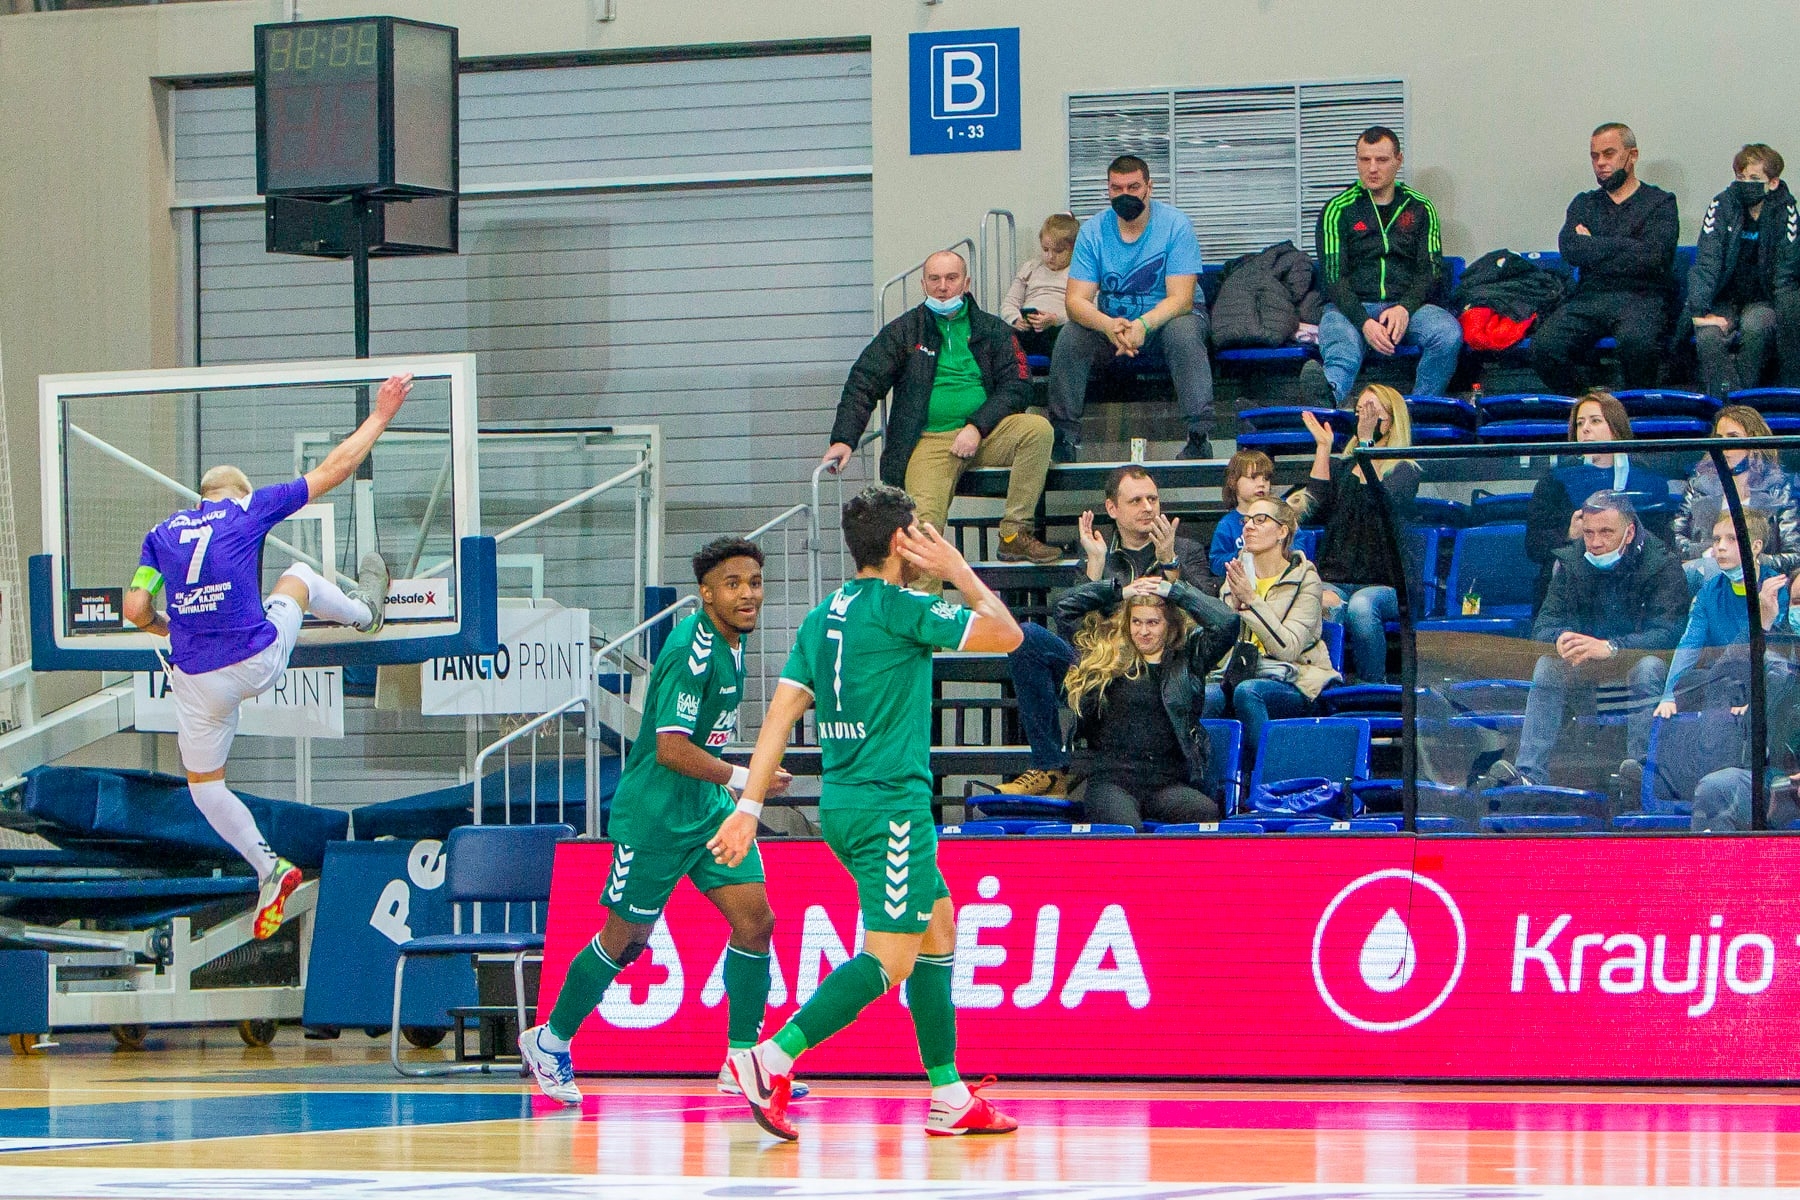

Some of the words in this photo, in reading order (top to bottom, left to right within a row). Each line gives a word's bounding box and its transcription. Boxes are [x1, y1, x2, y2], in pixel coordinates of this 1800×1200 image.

[943, 51, 986, 112] B
[946, 126, 954, 139] 1
[967, 125, 985, 138] 33
[179, 524, 213, 585] 7
[74, 603, 120, 622] JKL
[519, 642, 585, 681] PRINT
[255, 670, 335, 708] RINT
[701, 876, 1151, 1008] NĖJA
[1510, 913, 1776, 1018] Kraujo
